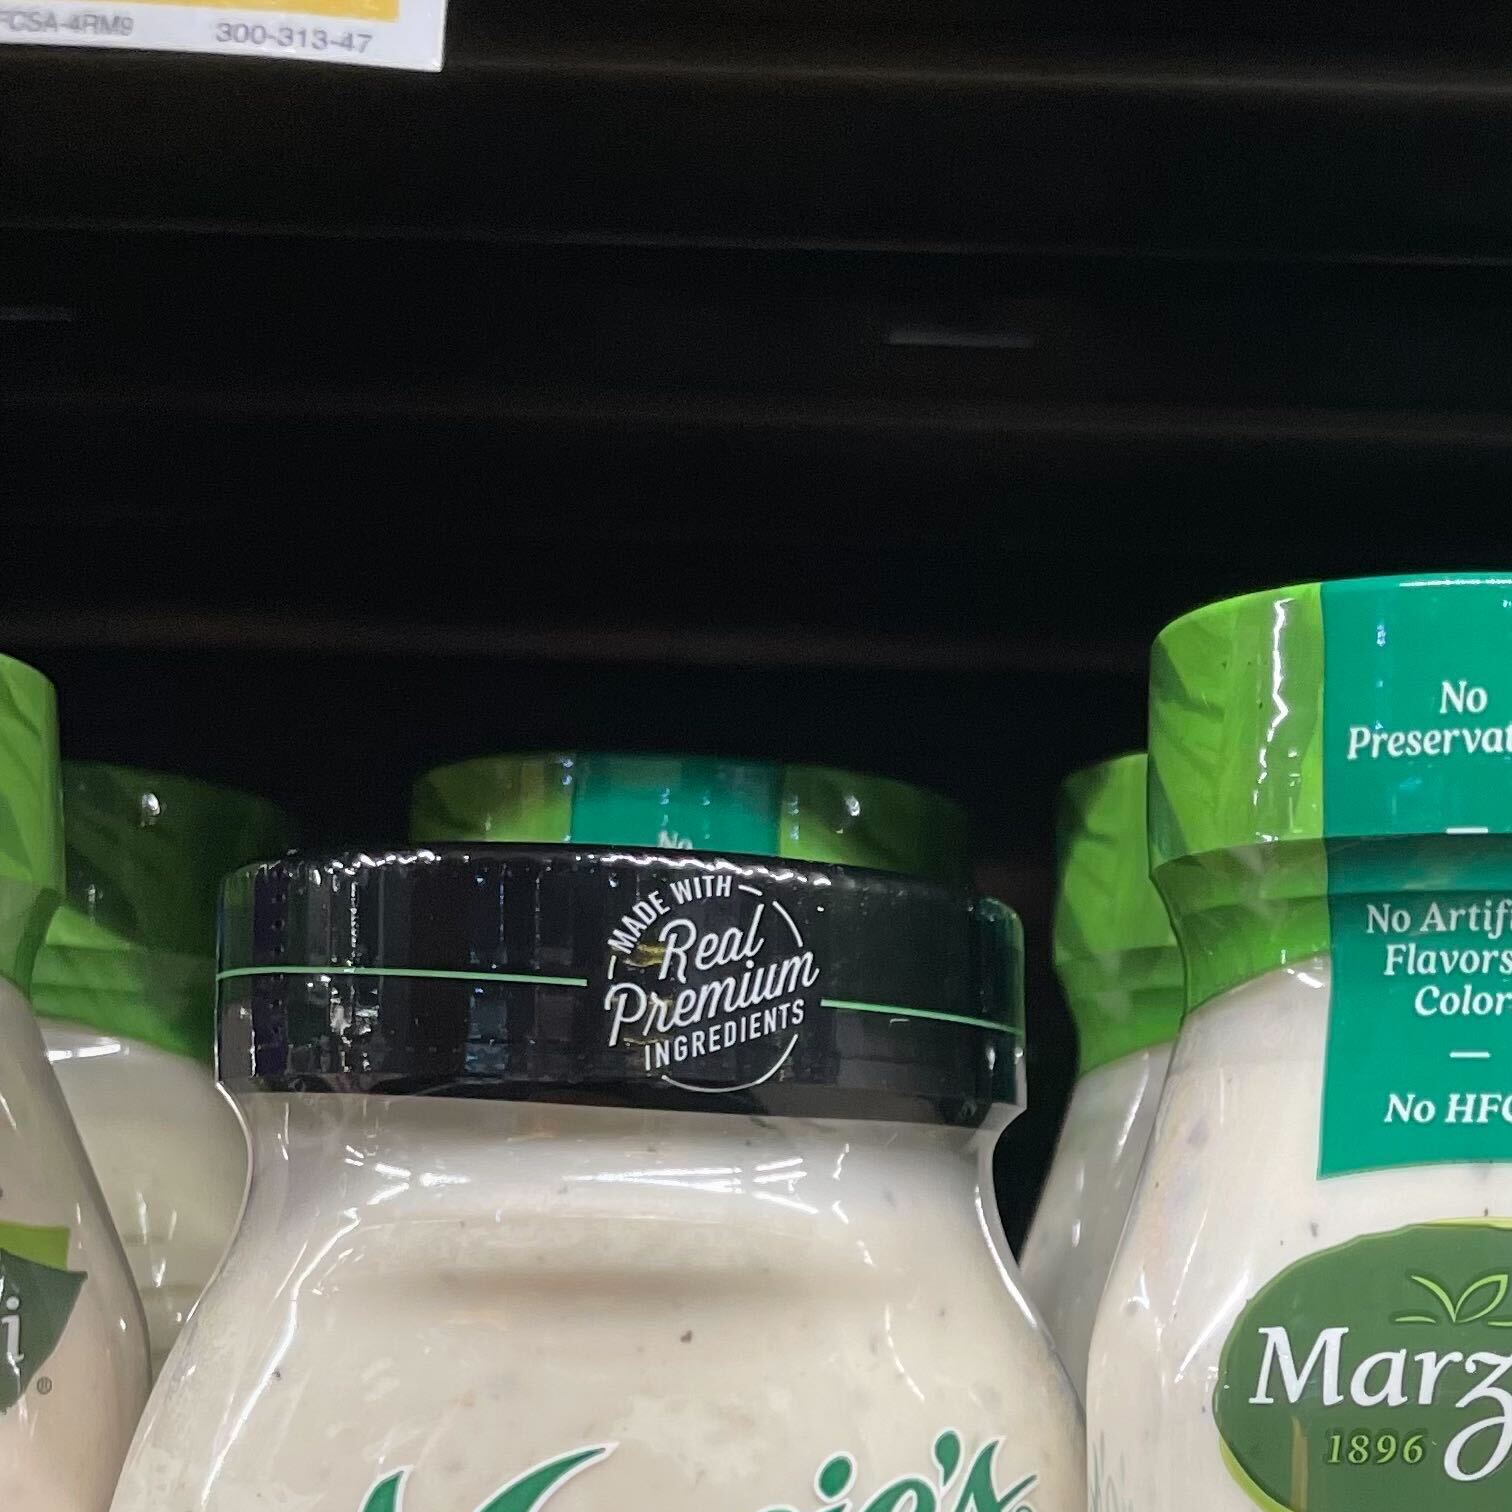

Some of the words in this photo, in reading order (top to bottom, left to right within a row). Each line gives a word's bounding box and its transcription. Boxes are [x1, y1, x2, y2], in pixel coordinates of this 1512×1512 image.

[1439, 681, 1488, 714] No
[607, 890, 671, 955] MADE
[670, 875, 732, 906] WITH
[1366, 903, 1411, 934] No
[658, 903, 764, 984] Real
[604, 951, 820, 1047] Premium
[645, 999, 804, 1071] INGREDIENTS
[1383, 1093, 1436, 1123] No
[1326, 1434, 1425, 1464] 1896
